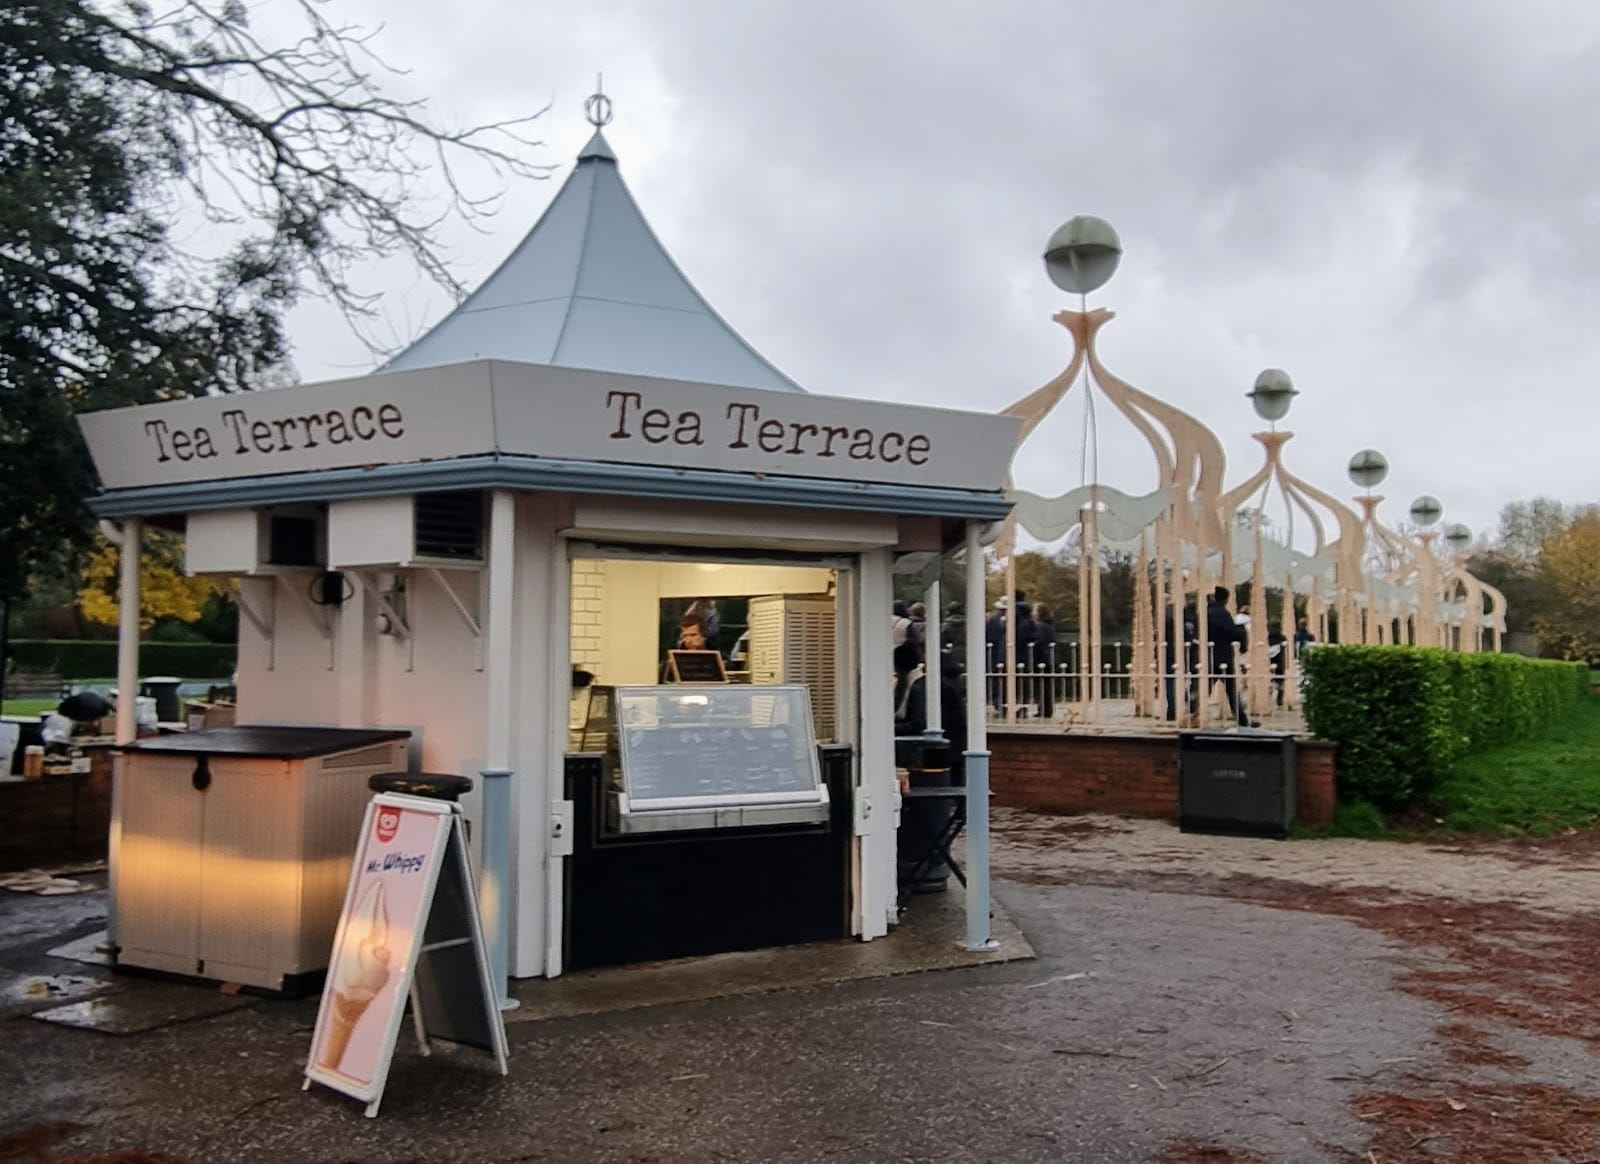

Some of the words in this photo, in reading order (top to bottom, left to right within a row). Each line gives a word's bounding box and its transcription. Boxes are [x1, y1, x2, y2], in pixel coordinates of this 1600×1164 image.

[145, 419, 218, 462] Tea
[222, 403, 405, 454] Terrace
[606, 390, 705, 446] Tea
[726, 402, 931, 466] Terrace
[383, 851, 426, 874] Whippy
